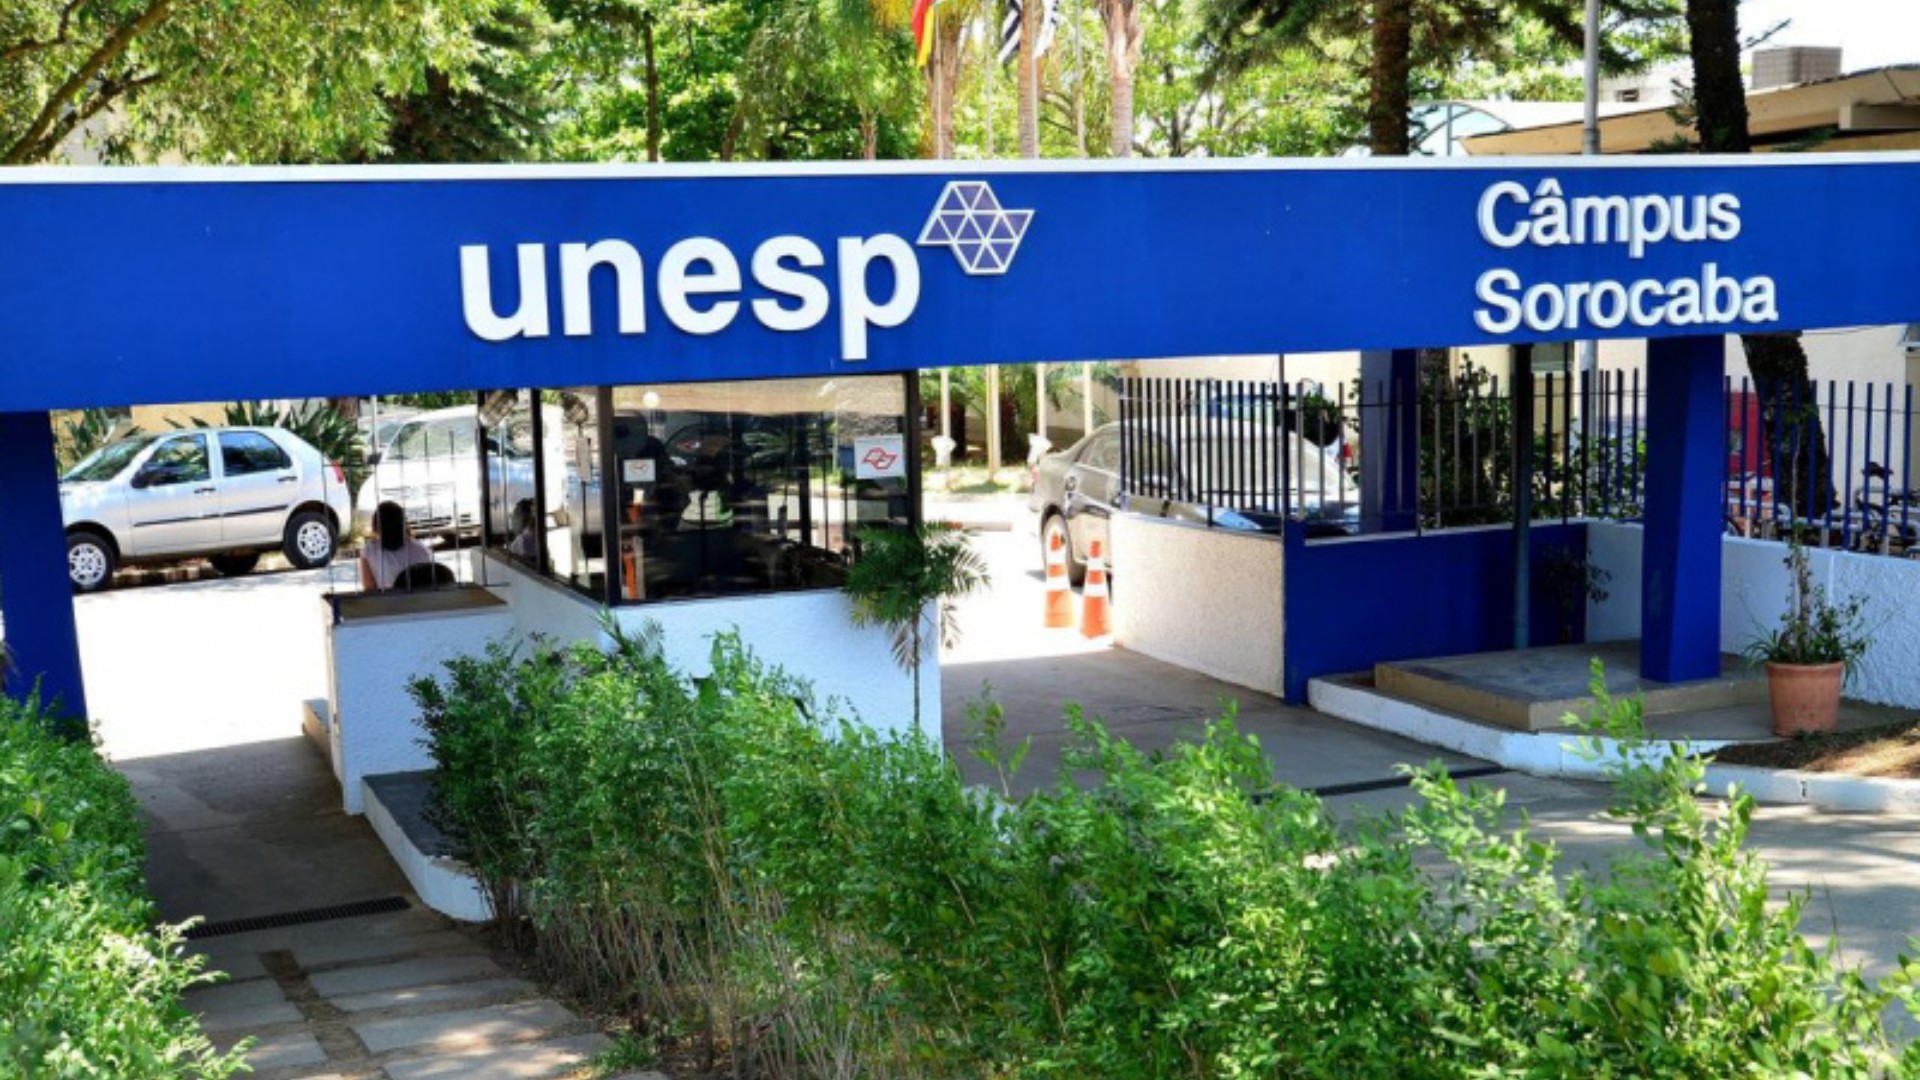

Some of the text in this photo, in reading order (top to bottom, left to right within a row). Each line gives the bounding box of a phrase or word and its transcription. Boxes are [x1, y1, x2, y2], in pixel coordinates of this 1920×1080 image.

[1477, 178, 1742, 258] Câmpus
[459, 232, 920, 360] unesp
[1474, 262, 1779, 334] Sorocaba
